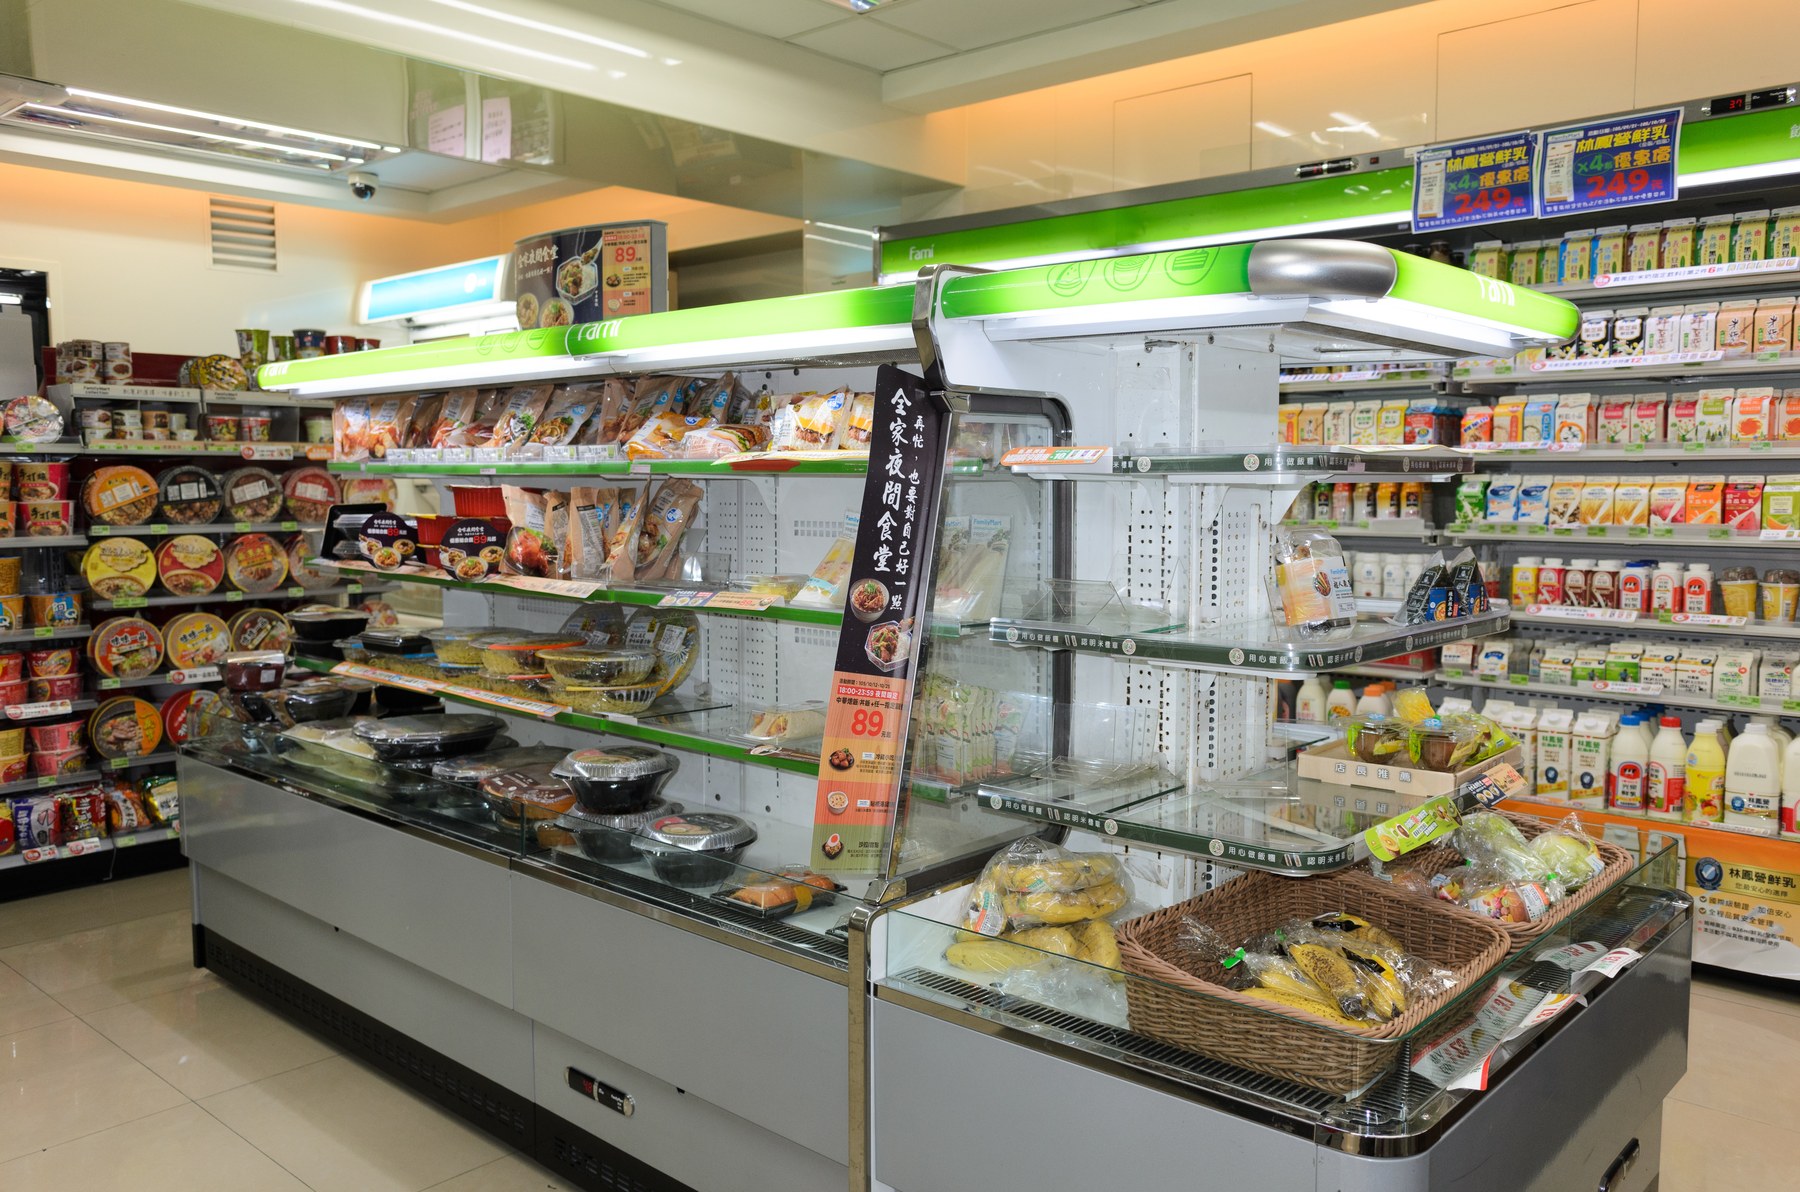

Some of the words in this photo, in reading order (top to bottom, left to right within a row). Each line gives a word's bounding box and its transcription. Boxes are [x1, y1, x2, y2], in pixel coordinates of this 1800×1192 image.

[1614, 146, 1671, 169] 優惠價
[909, 244, 935, 260] Fami
[873, 388, 912, 572] 全家夜間食堂
[890, 416, 925, 611] 再忙，也要對自己好一點
[110, 630, 148, 646] 味味一品
[180, 624, 214, 644] 味味一品
[240, 616, 269, 645] 味味一品
[839, 686, 874, 697] 18:00-23:59
[1335, 762, 1412, 783] 店長推薦
[1228, 846, 1276, 862] 用心做飯糰
[1728, 868, 1796, 888] 林鳳營鮮乳
